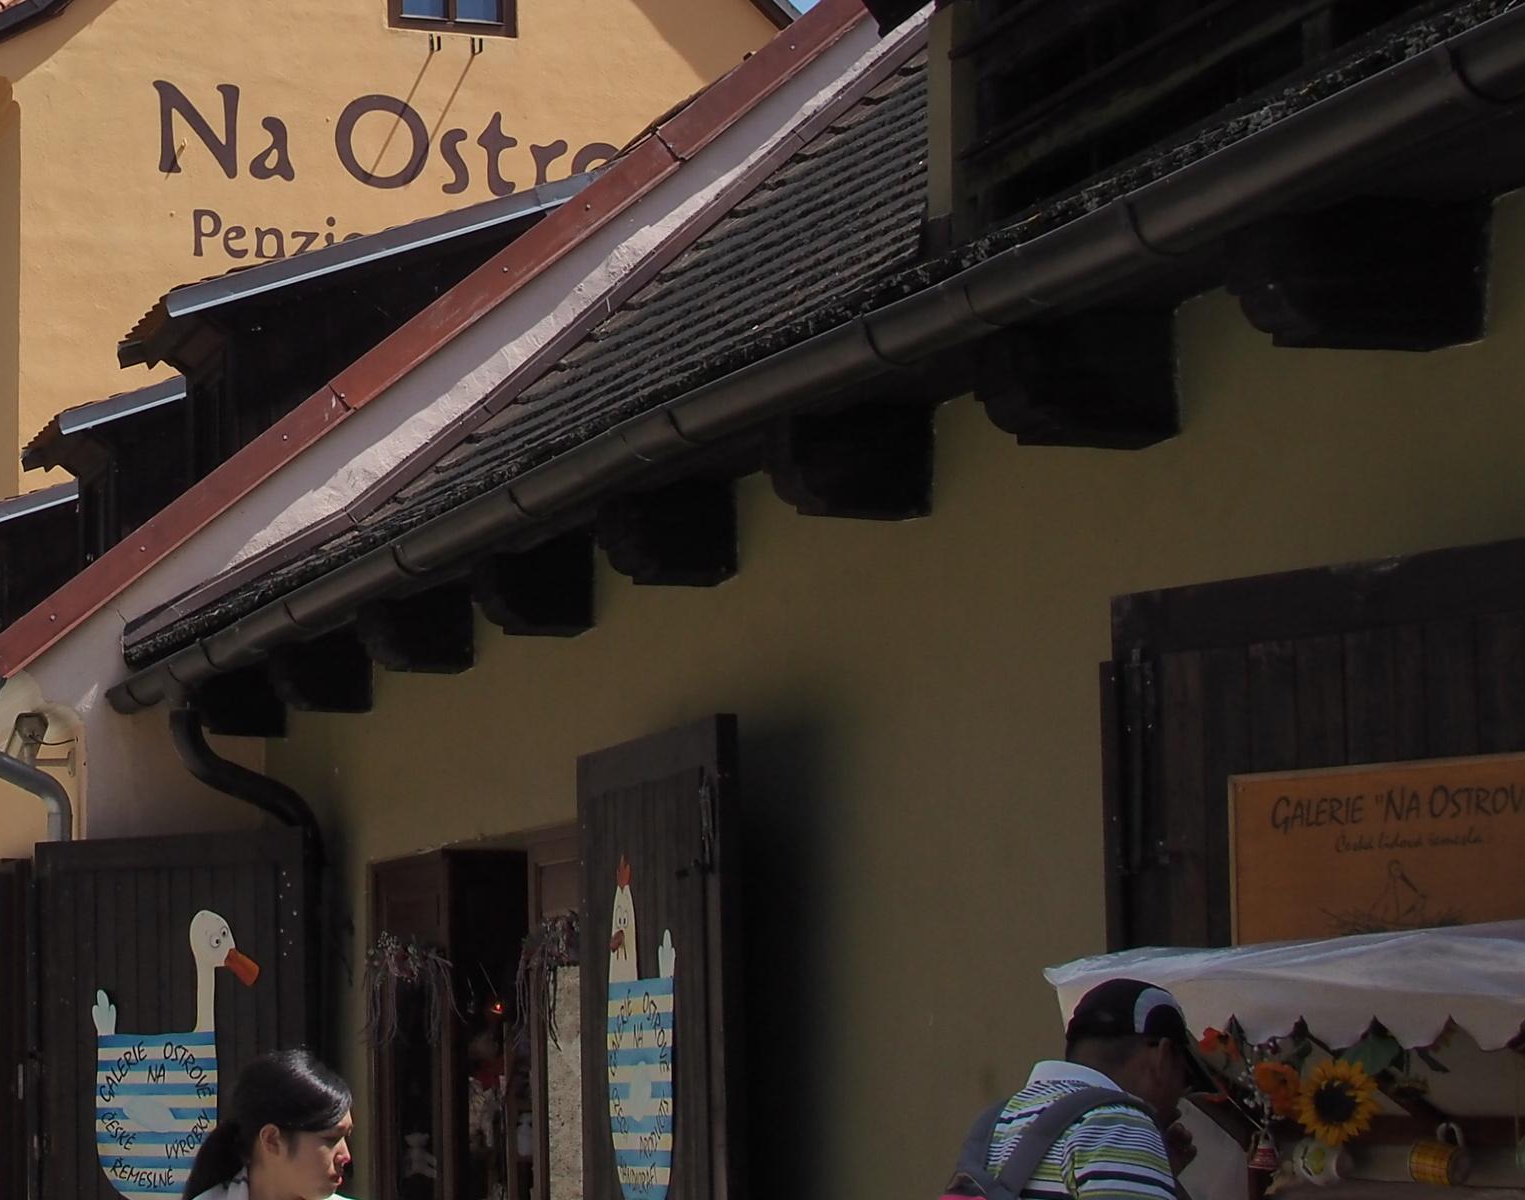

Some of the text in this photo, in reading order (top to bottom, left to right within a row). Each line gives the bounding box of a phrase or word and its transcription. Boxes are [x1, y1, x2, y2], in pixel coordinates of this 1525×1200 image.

[152, 80, 295, 182] Na
[192, 209, 364, 260] Penzi
[1271, 794, 1364, 834] GALERIE
[99, 1041, 147, 1103] GALERIE
[147, 1063, 166, 1085] NA
[100, 1111, 136, 1151] ČESKÉ
[165, 1108, 211, 1160] VÝROBKY
[110, 1157, 175, 1189] ŘEMESLNÉ
